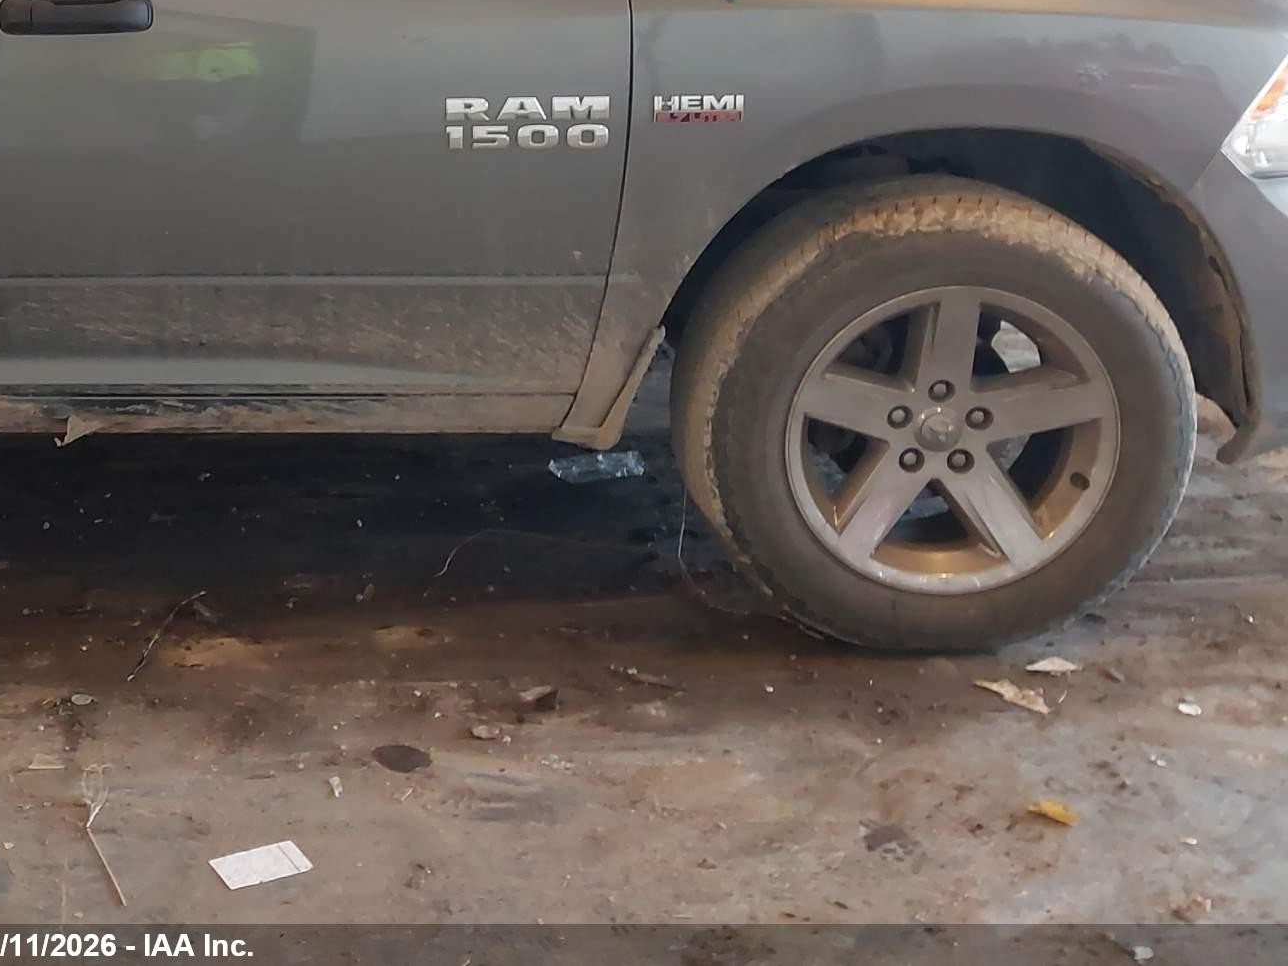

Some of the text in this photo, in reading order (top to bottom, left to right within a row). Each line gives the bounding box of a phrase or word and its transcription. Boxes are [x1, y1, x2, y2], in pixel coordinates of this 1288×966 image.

[445, 95, 611, 121] RAM
[654, 94, 745, 111] HEMI
[446, 123, 610, 150] 1500
